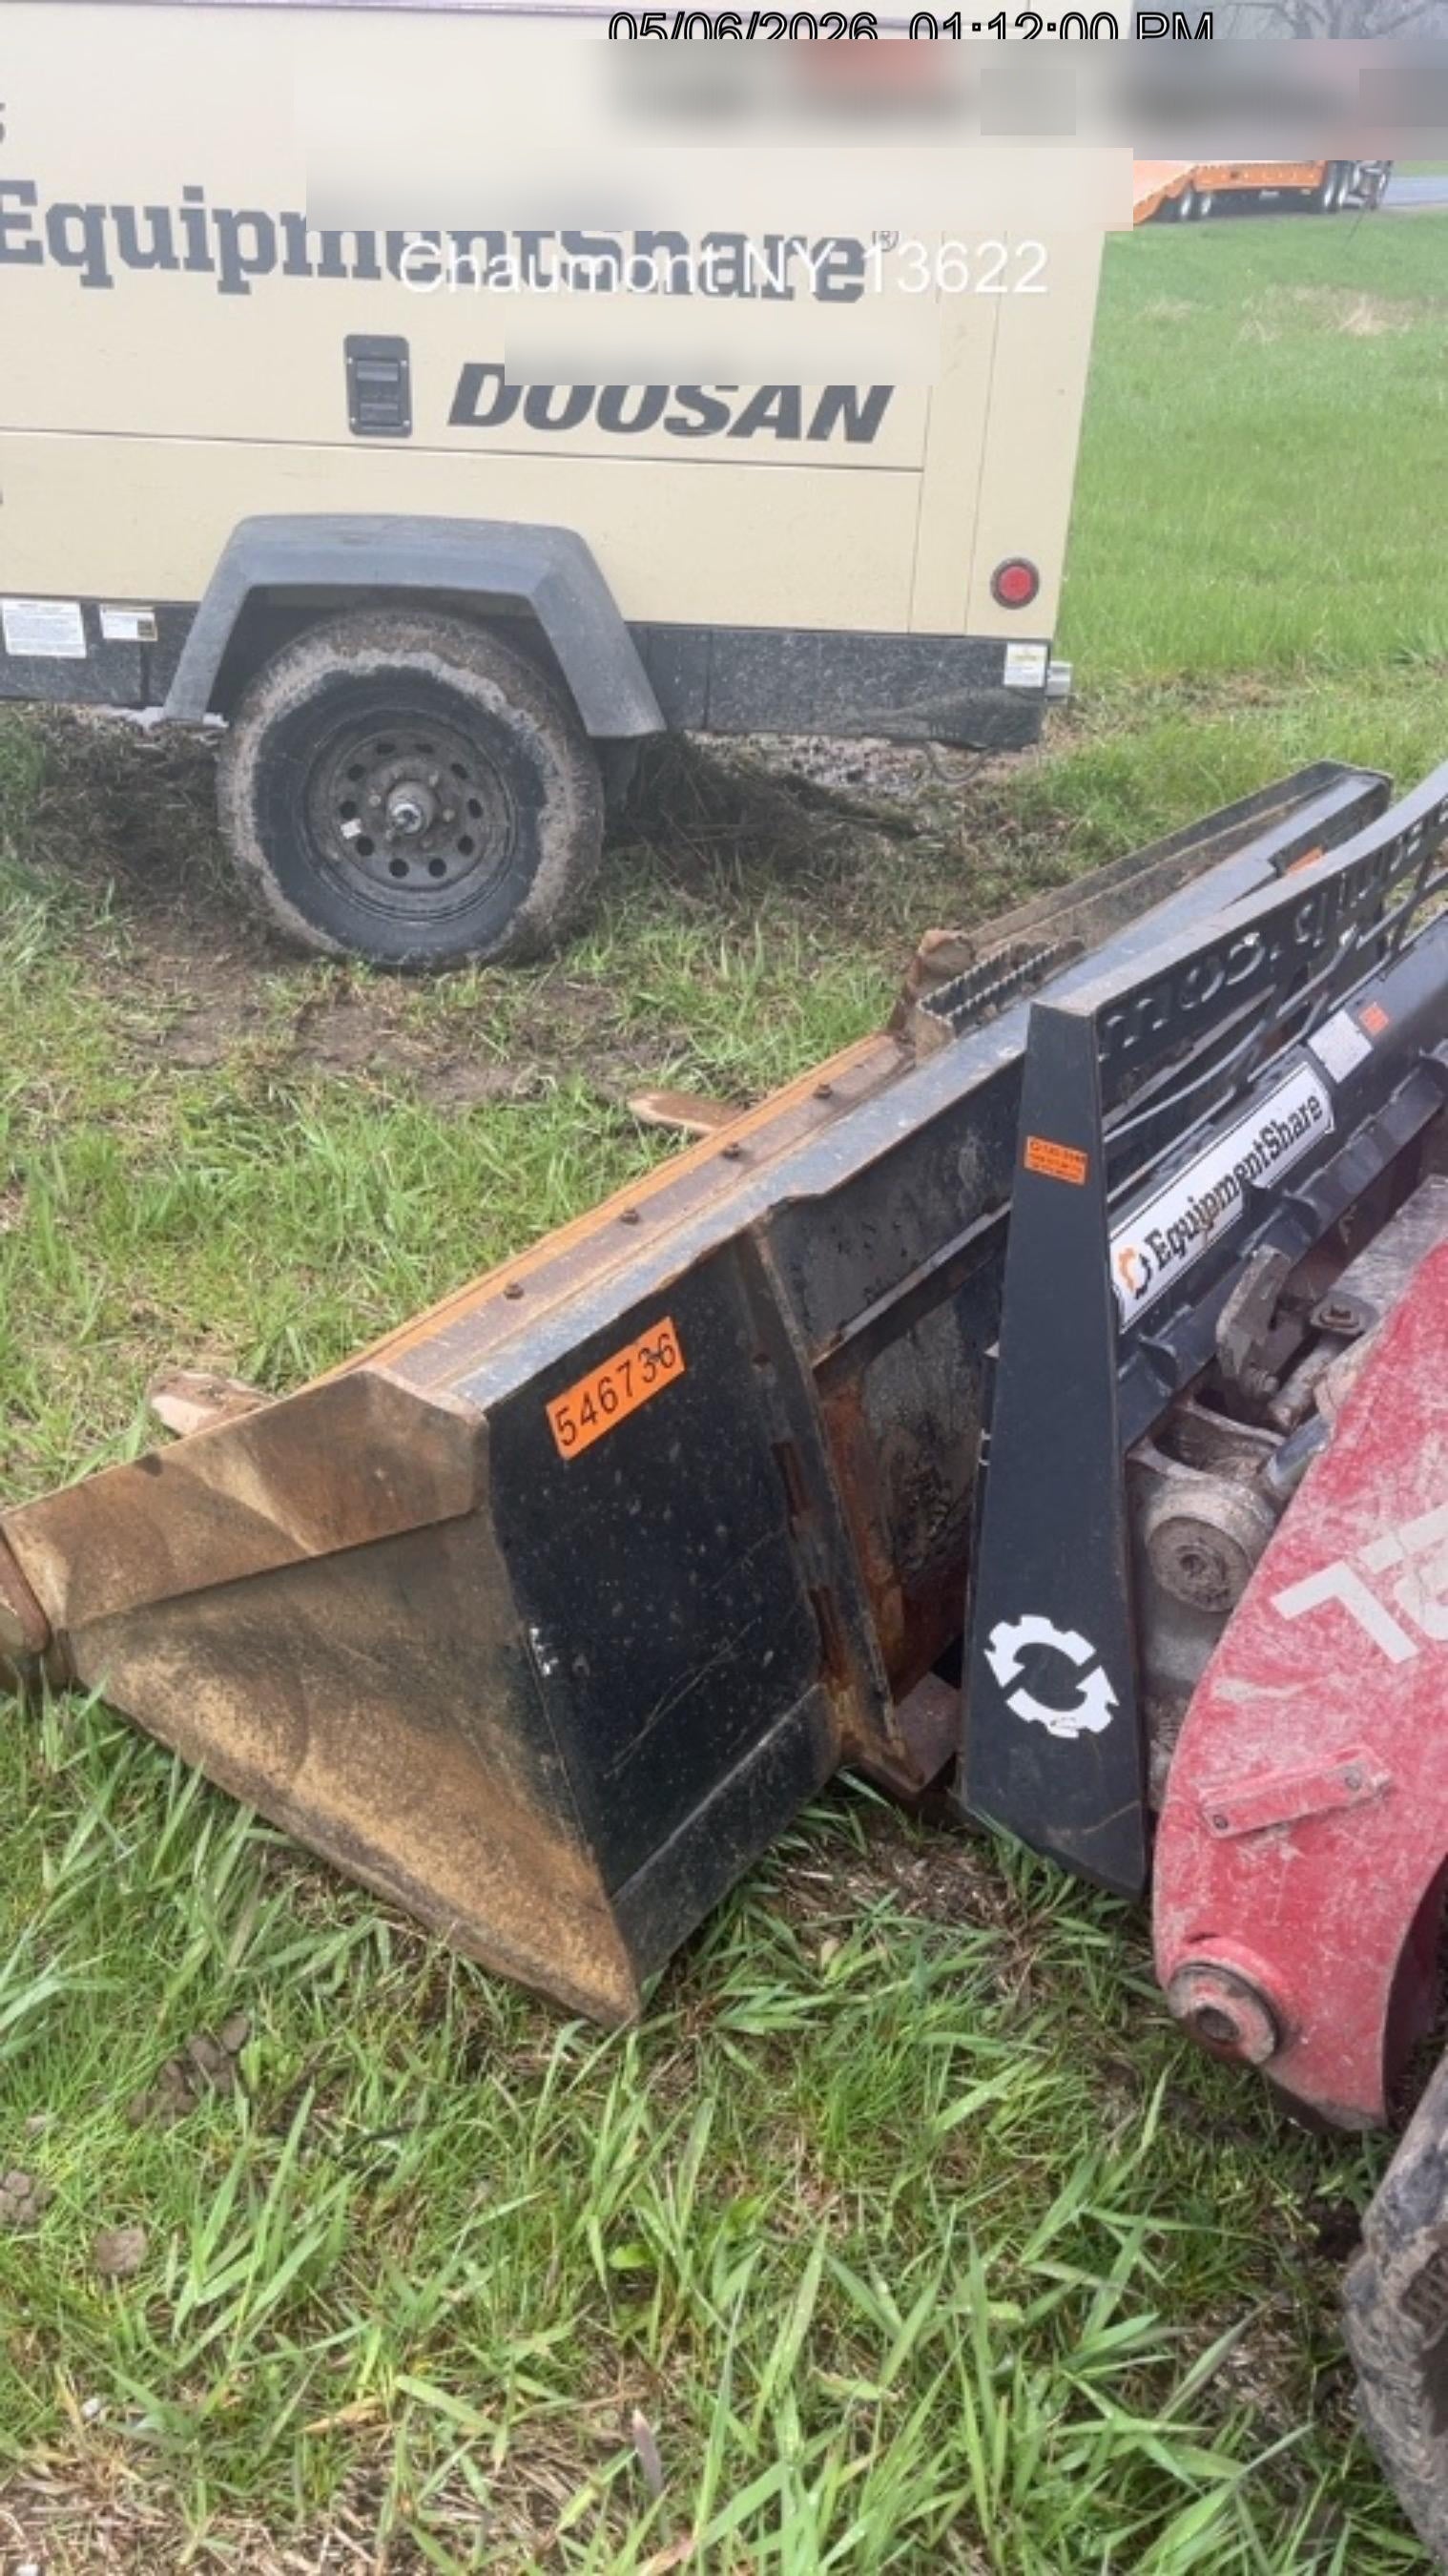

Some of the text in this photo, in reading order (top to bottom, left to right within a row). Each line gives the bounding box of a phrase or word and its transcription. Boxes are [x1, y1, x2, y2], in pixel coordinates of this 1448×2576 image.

[447, 363, 896, 443] DOOSAN
[1144, 1095, 1321, 1272] EquipmentShare
[553, 1332, 676, 1446] 546736
